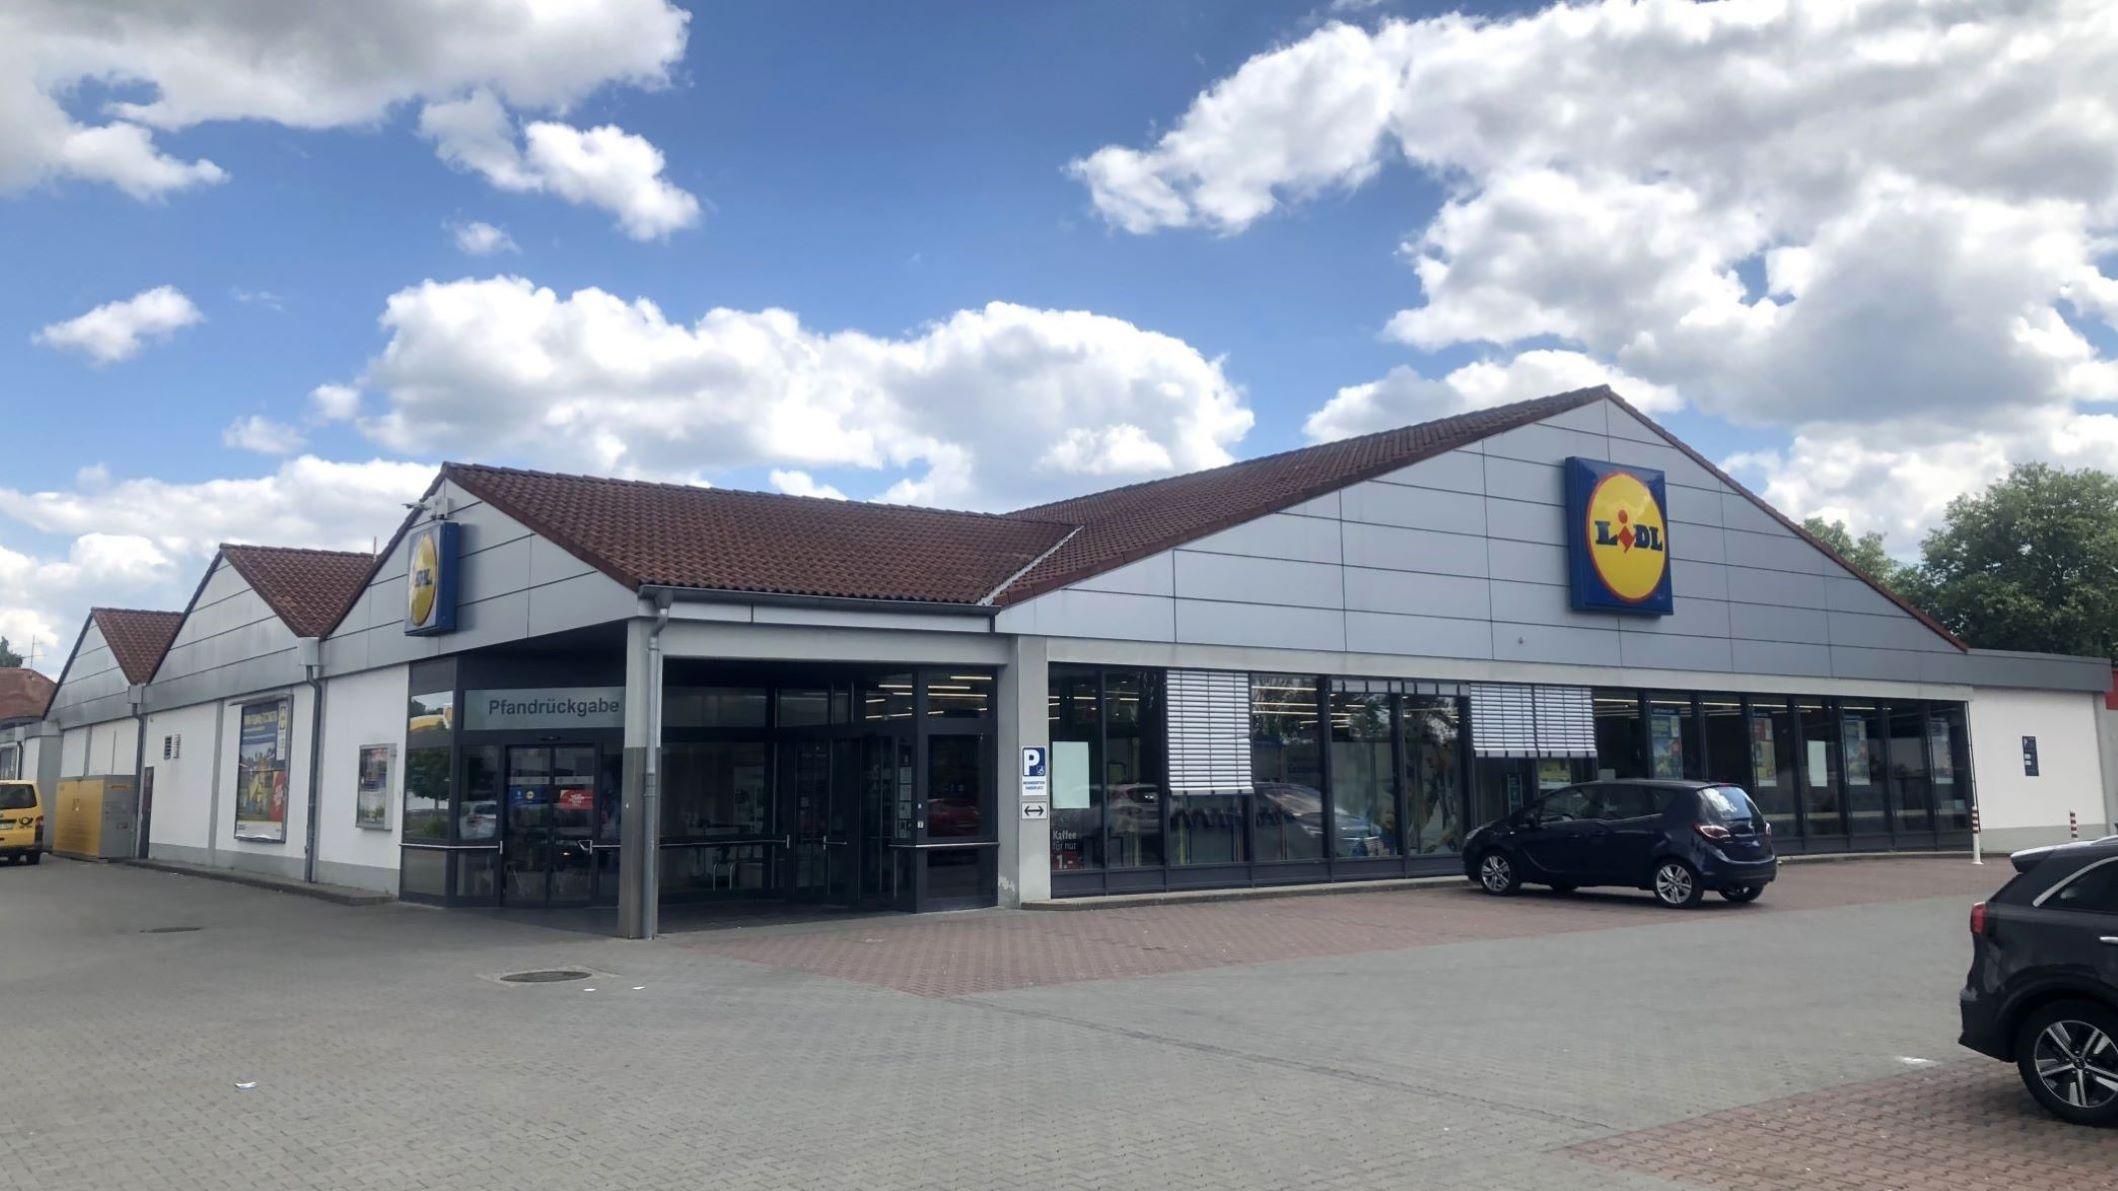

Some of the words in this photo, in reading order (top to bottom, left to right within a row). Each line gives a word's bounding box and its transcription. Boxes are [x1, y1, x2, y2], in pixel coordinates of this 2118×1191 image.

[488, 697, 620, 717] Pfandrückgabe
[1023, 748, 1040, 776] P
[1052, 829, 1077, 840] Kaffee
